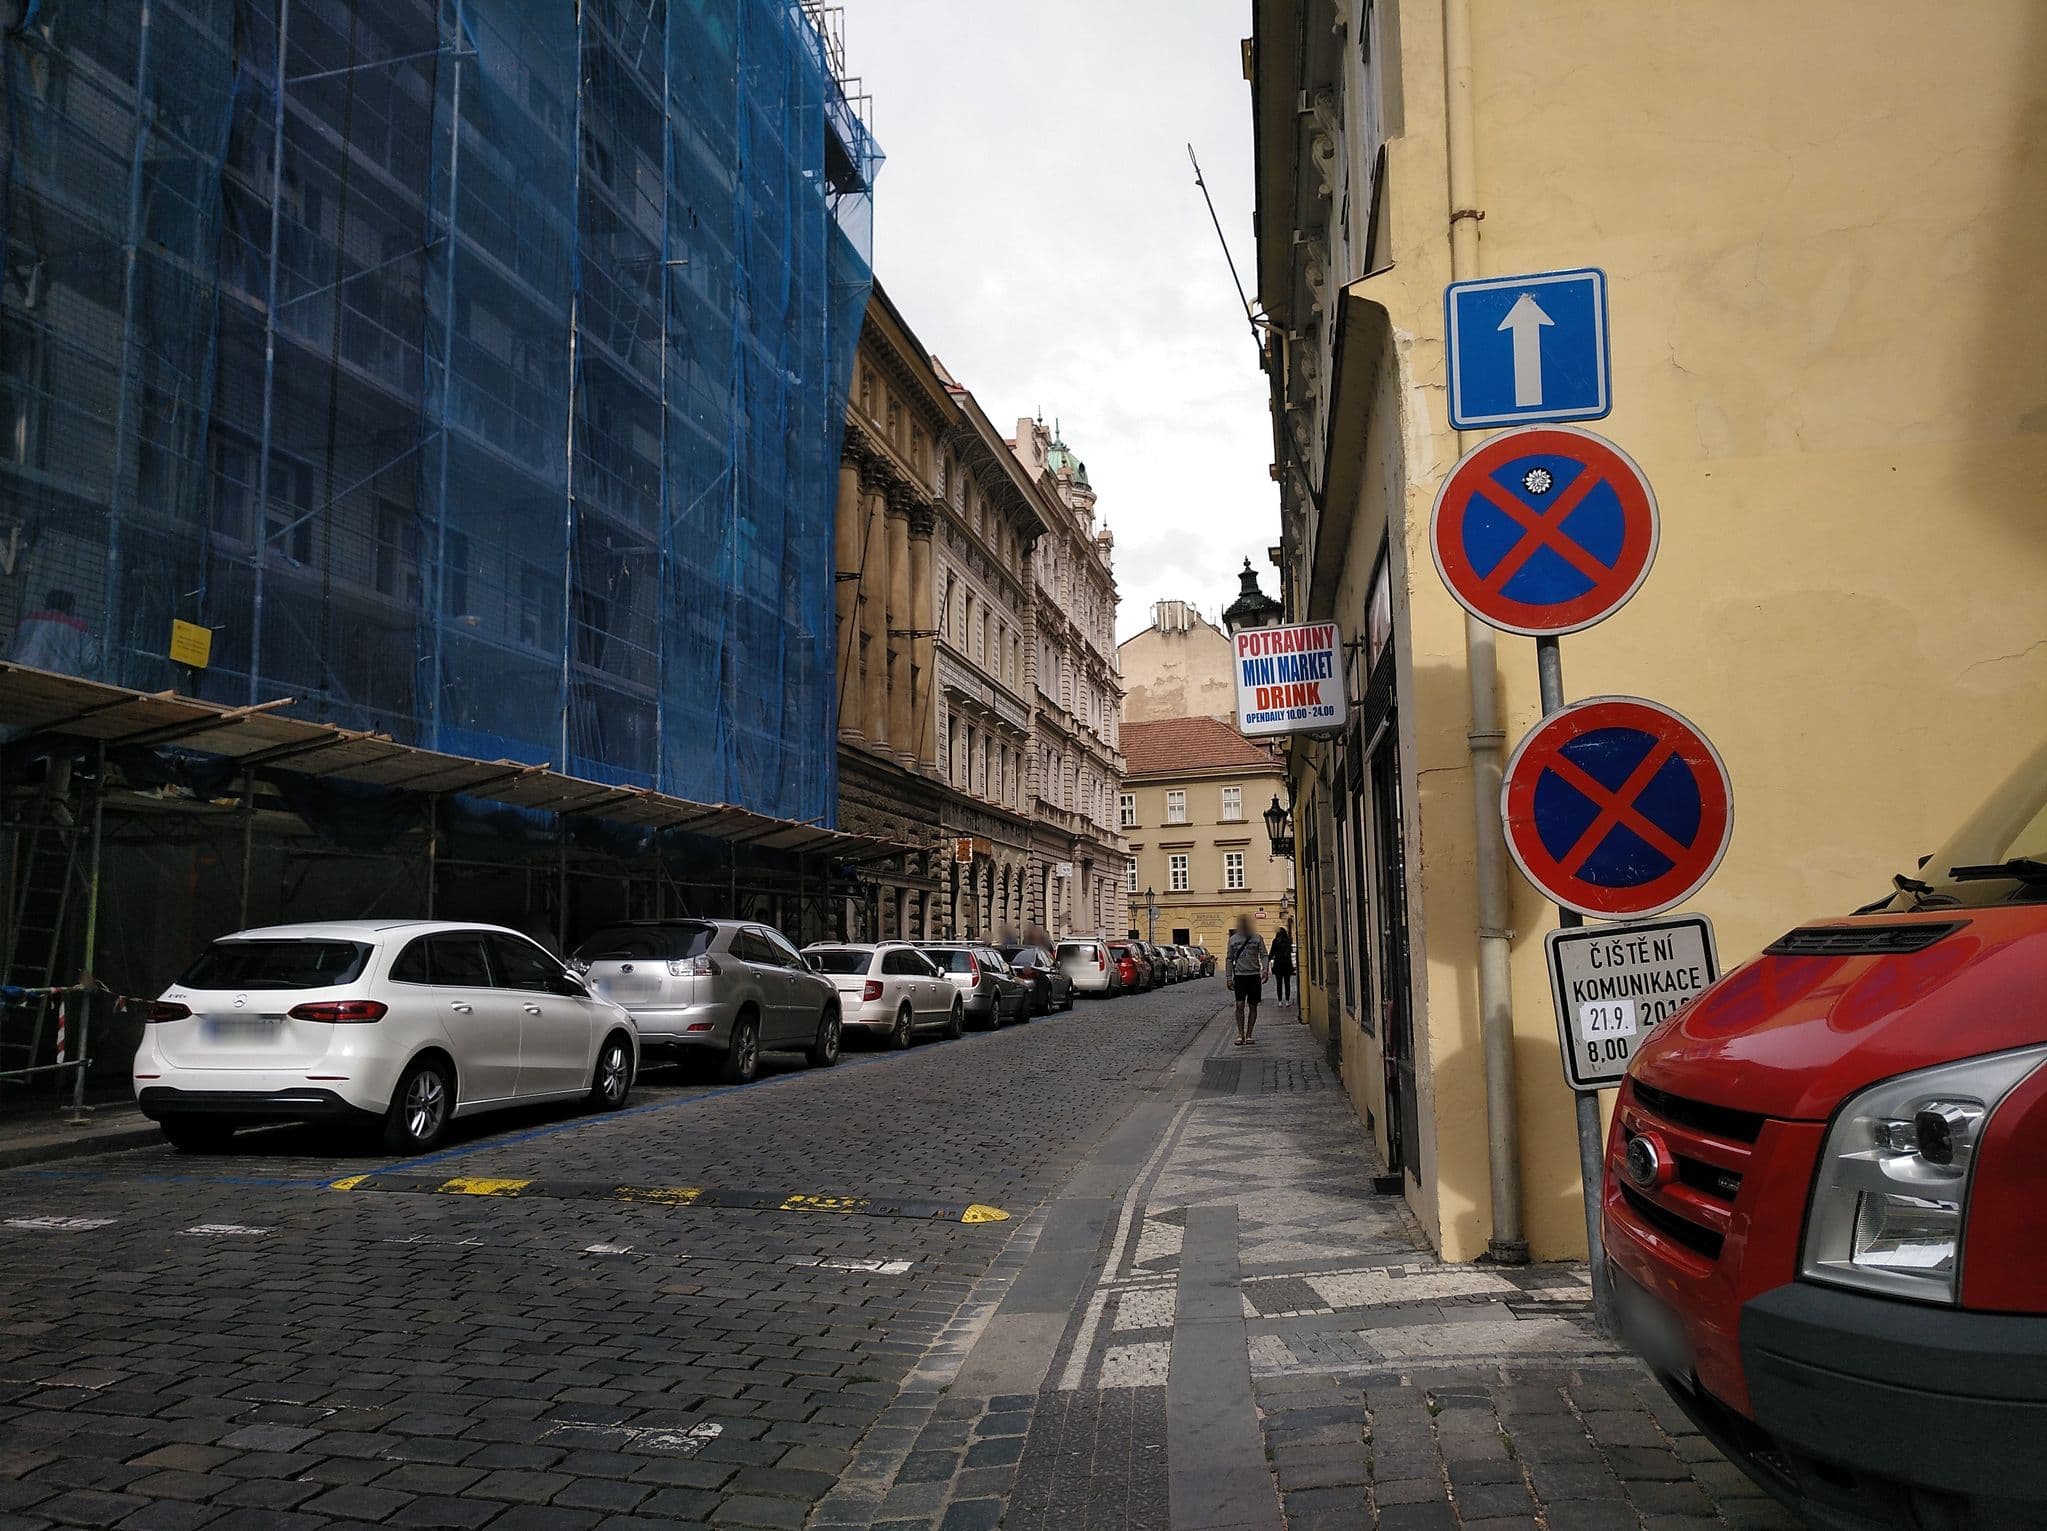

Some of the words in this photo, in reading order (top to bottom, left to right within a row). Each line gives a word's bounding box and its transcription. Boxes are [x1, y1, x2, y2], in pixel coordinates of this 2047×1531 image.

[1238, 625, 1334, 657] POTRAVINY
[1242, 657, 1275, 687] MINI
[1278, 651, 1333, 683] MARKET
[1256, 682, 1322, 710] DRINK
[1286, 708, 1307, 720] 10.00
[1313, 706, 1334, 717] 24.00
[1590, 934, 1674, 969] ČIŠTĚNÍ
[1573, 967, 1702, 1003] KOMUNIKACE
[1590, 1007, 1629, 1031] 21.9.
